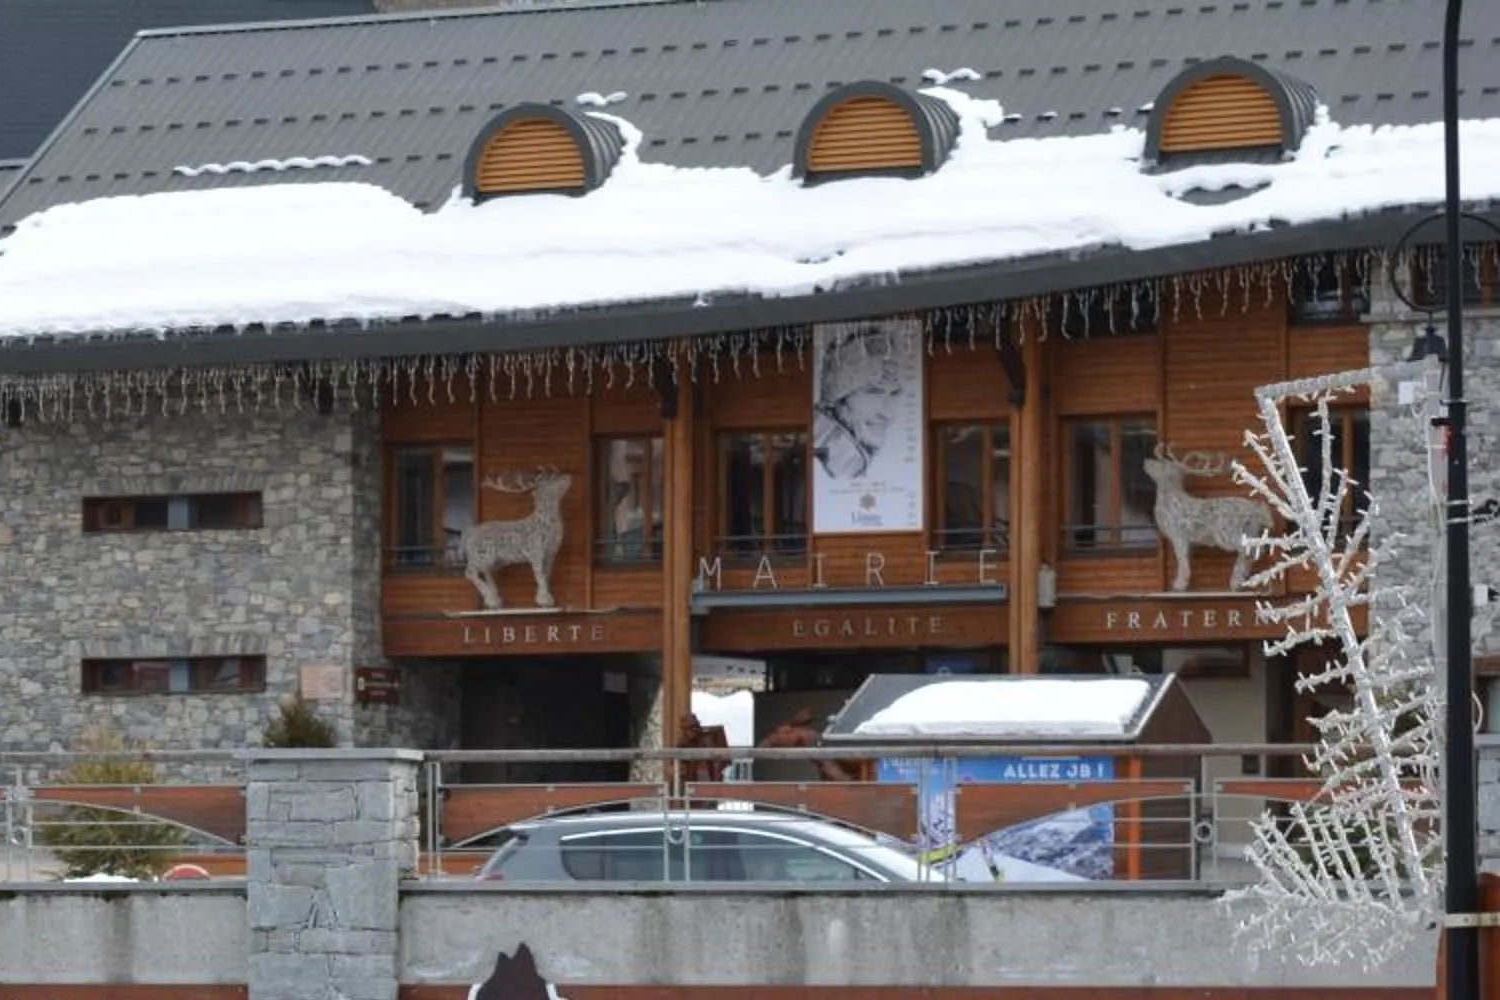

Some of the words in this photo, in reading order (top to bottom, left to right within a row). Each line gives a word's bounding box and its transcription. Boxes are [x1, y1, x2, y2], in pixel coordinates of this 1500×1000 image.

[699, 549, 998, 591] MAIRIE
[463, 623, 605, 644] LIBERTE
[1003, 763, 1061, 779] ALLEZ
[1066, 763, 1092, 779] JB
